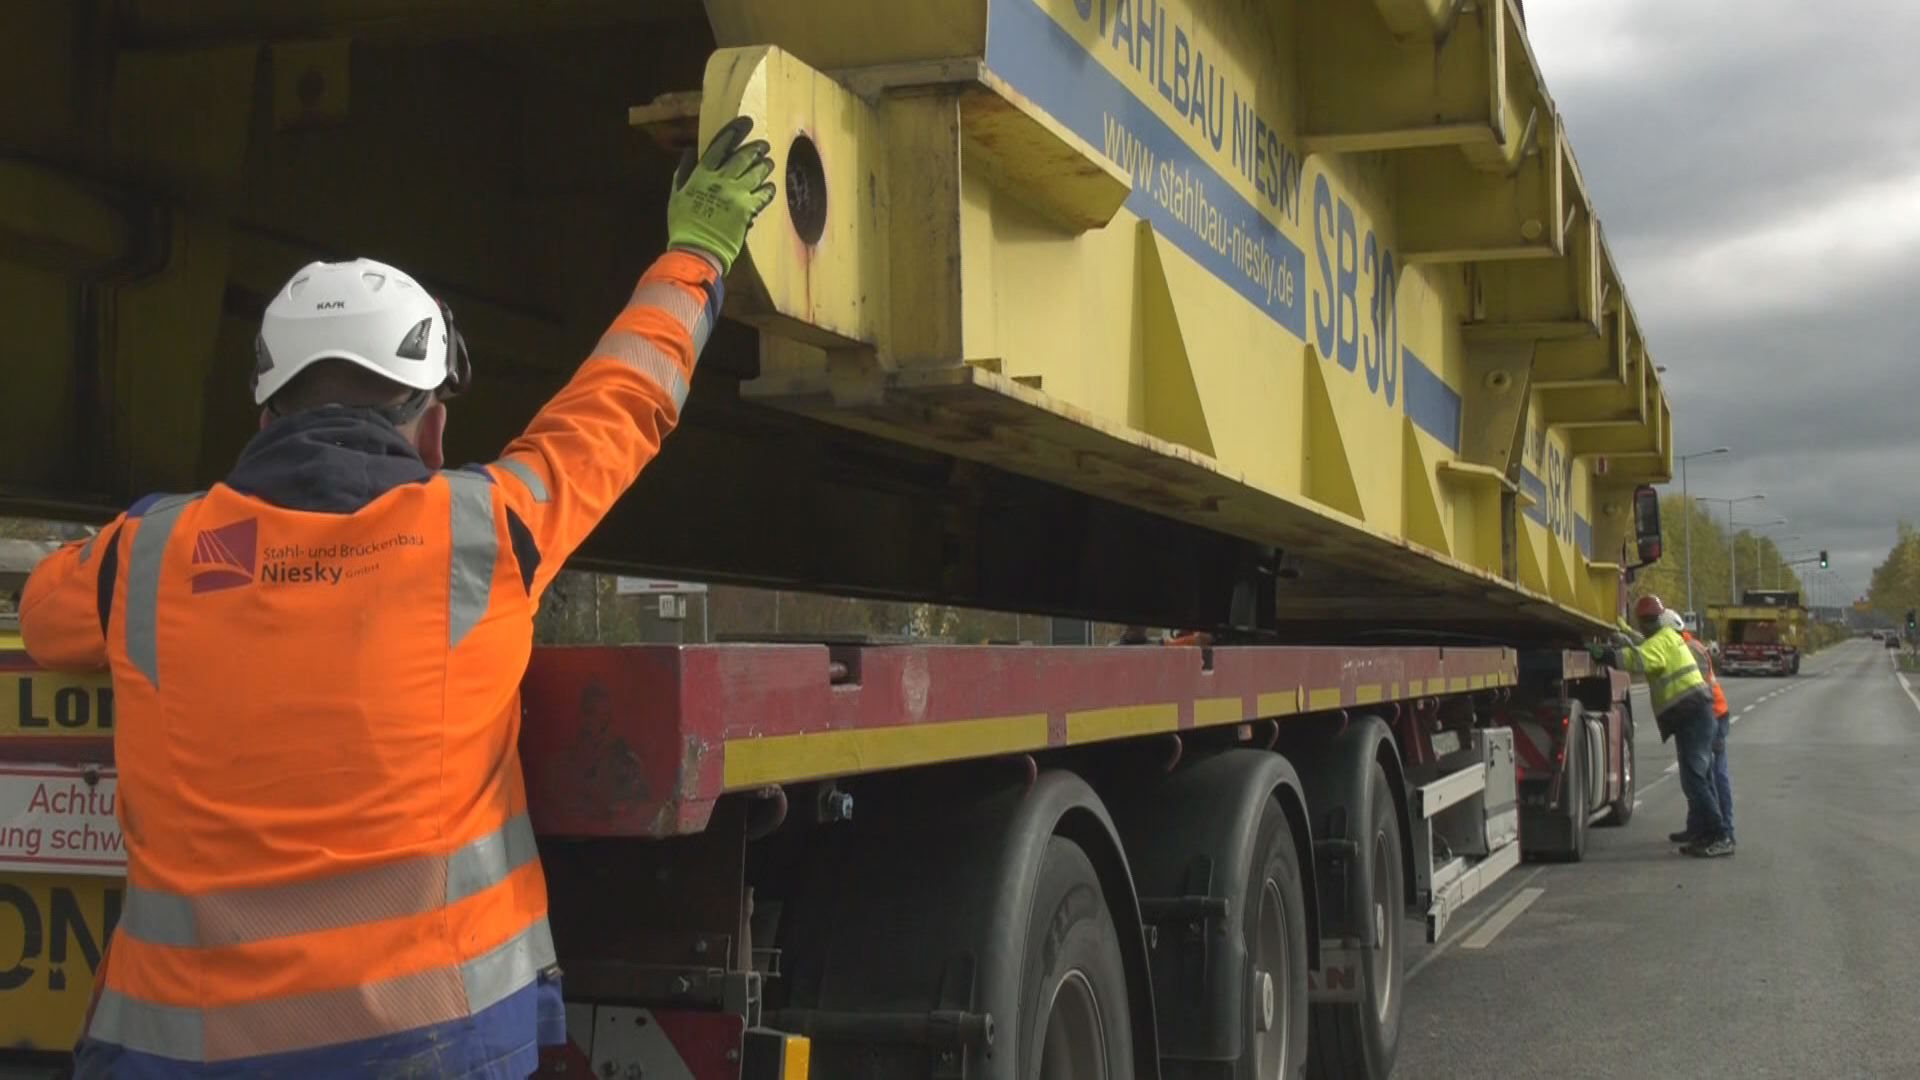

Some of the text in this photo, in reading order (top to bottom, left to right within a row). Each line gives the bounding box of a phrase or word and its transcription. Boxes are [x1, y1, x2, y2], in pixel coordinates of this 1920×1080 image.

[1074, 0, 1303, 227] AHLBAU NIESKY
[1103, 111, 1295, 308] www.stahlbau-niesky.de
[263, 543, 305, 560] Stahl-
[308, 544, 337, 558] und
[261, 561, 343, 585] Niesky
[0, 827, 42, 856] ng
